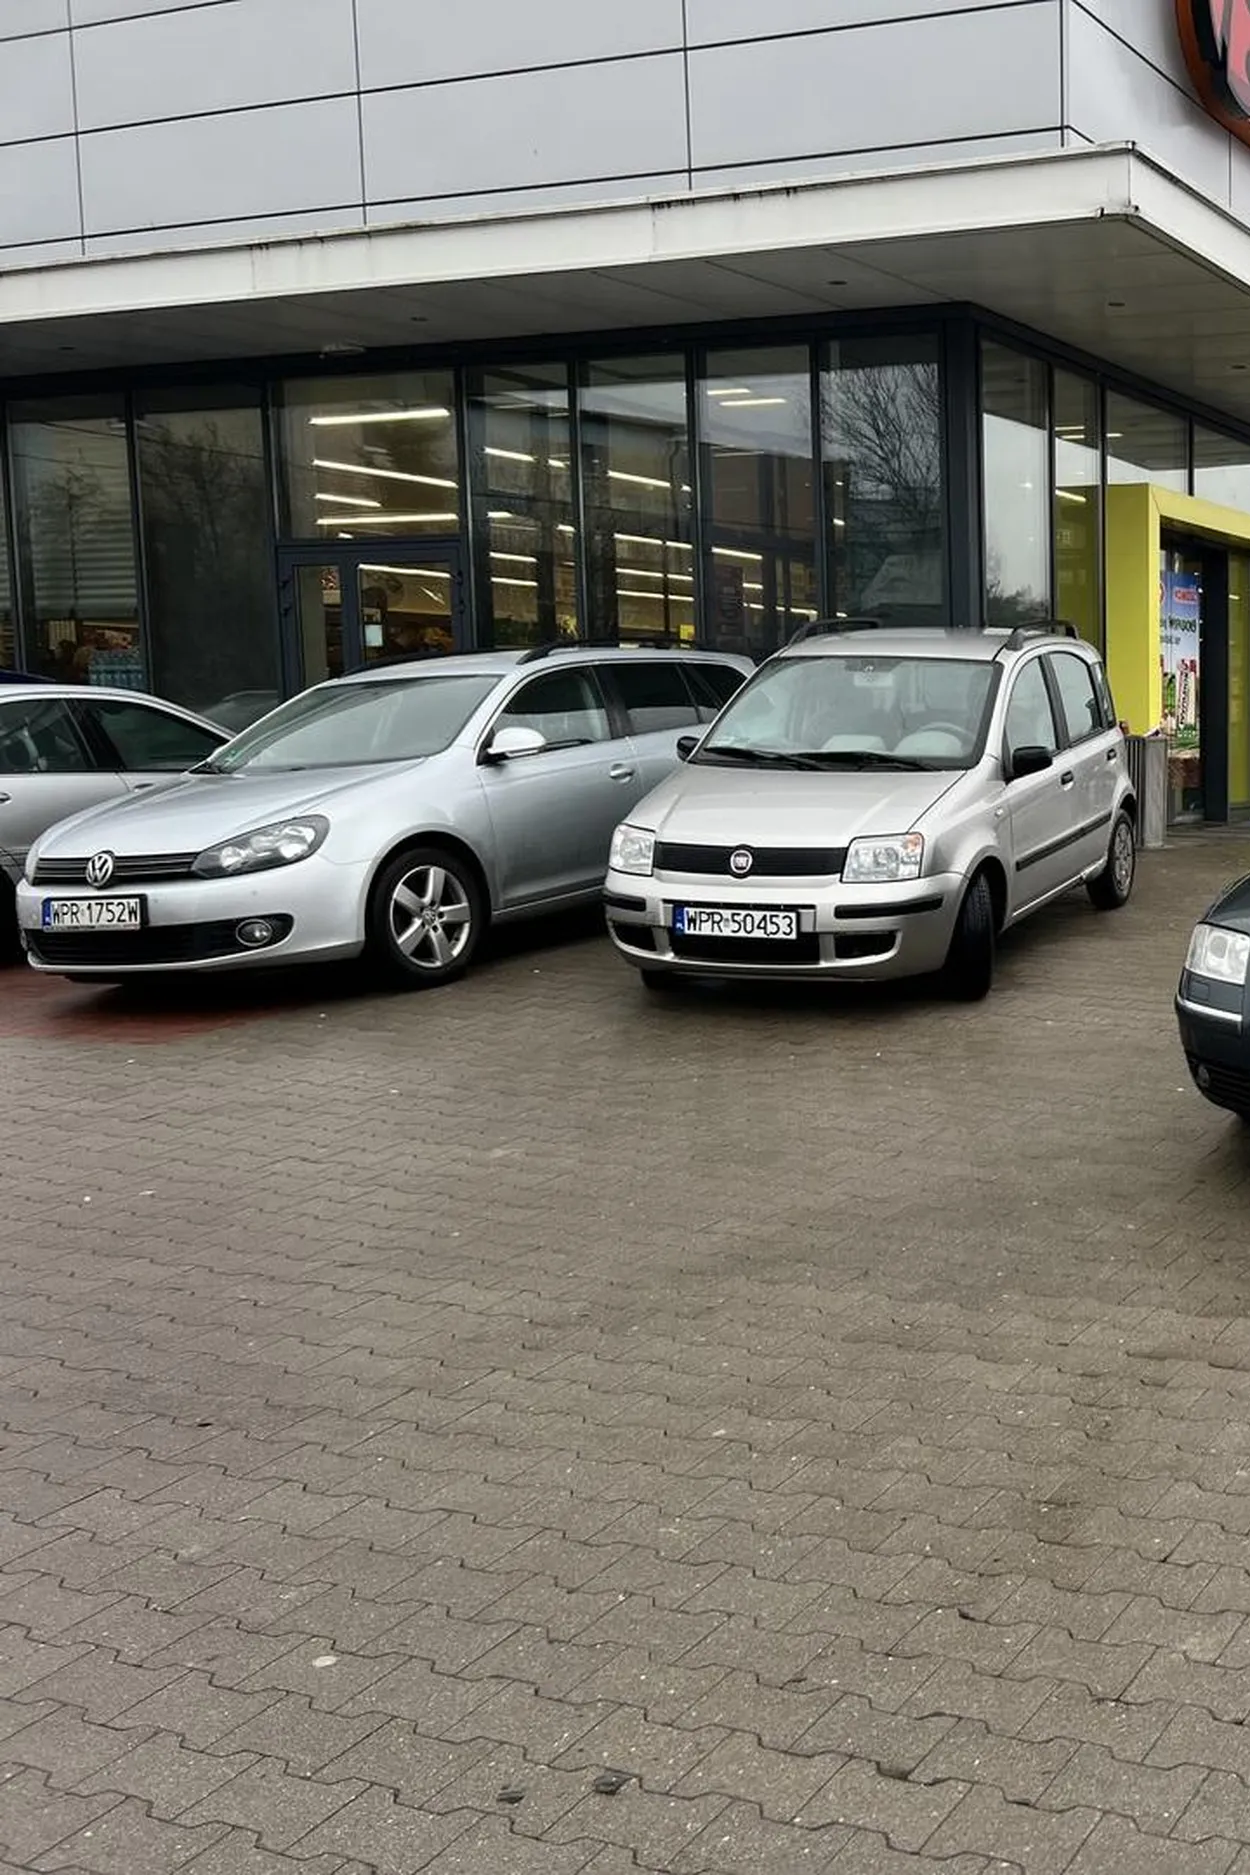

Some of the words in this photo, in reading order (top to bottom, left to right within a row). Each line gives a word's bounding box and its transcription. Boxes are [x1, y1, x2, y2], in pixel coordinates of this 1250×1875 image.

[52, 902, 80, 924] WPR
[87, 901, 138, 924] 1752W
[687, 910, 723, 933] WPR
[730, 912, 794, 936] 50453
